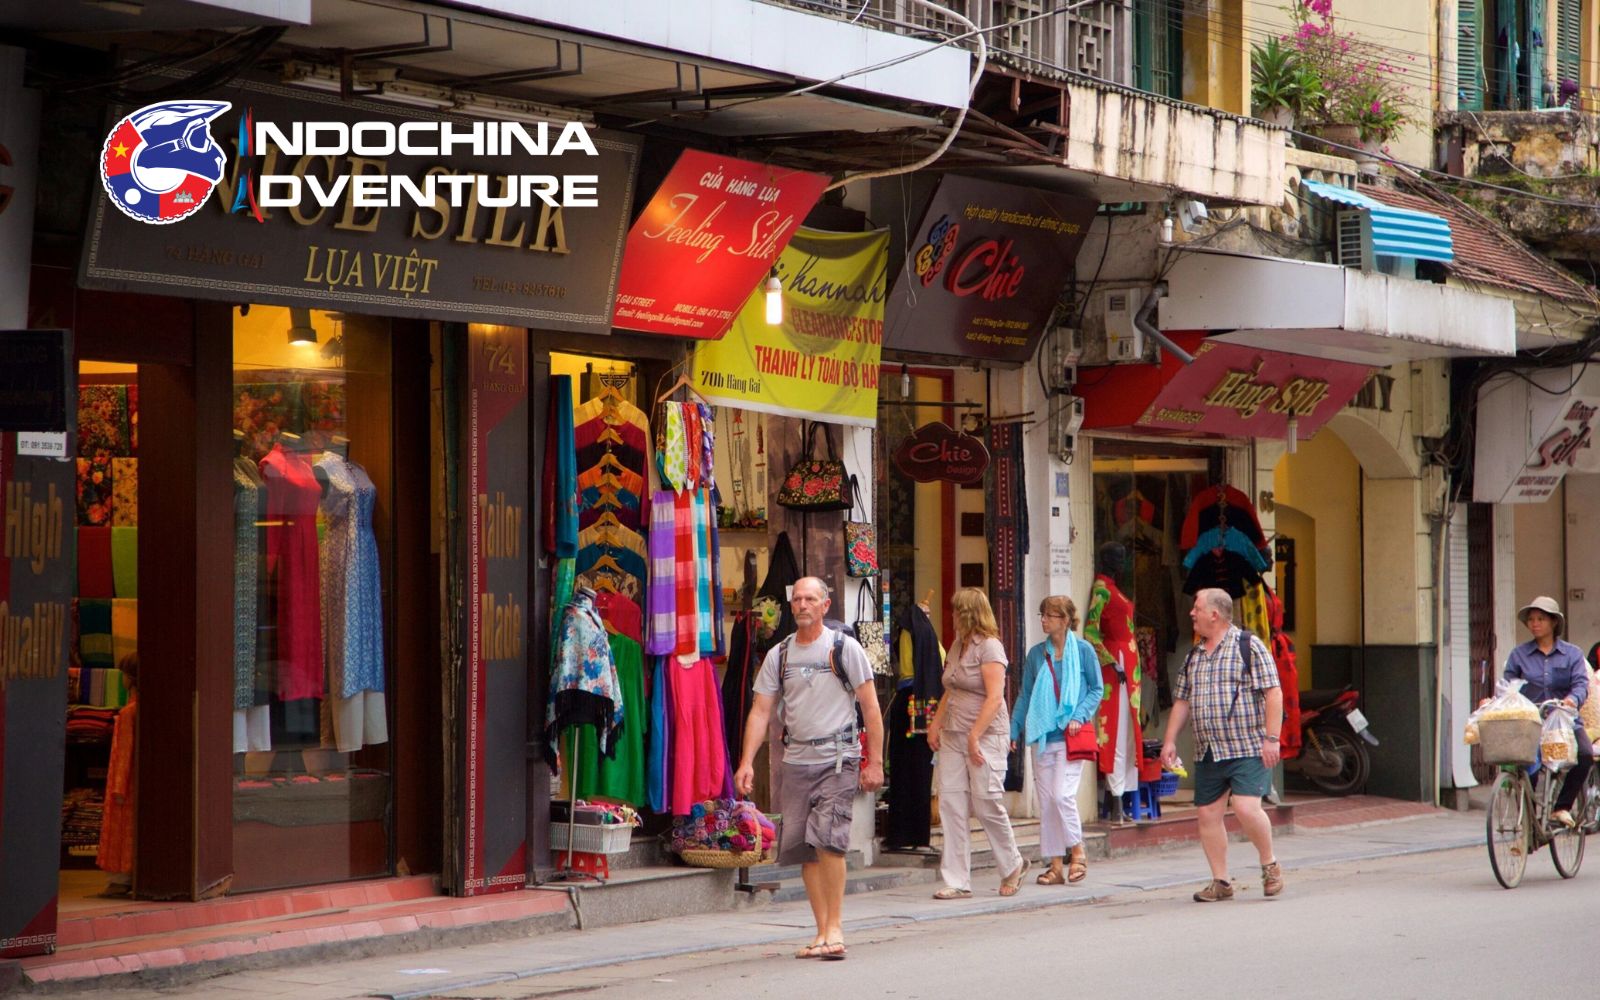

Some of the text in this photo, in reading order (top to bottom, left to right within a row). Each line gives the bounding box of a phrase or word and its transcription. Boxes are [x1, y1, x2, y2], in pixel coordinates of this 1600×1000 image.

[409, 165, 571, 254] SILK
[643, 192, 794, 264] Feeling Silk
[1032, 216, 1042, 228] of
[1058, 222, 1081, 236] groups
[373, 247, 439, 300] VIỆT
[951, 239, 1025, 300] Chie
[631, 296, 656, 308] STREET
[482, 343, 516, 376] 74
[755, 345, 800, 378] THANH
[749, 377, 761, 394] Gai
[1267, 376, 1331, 417] Silk
[910, 439, 972, 463] Chie
[1526, 422, 1590, 470] Silk
[4, 480, 64, 576] High
[479, 491, 522, 560] Tailor
[480, 592, 521, 661] Made
